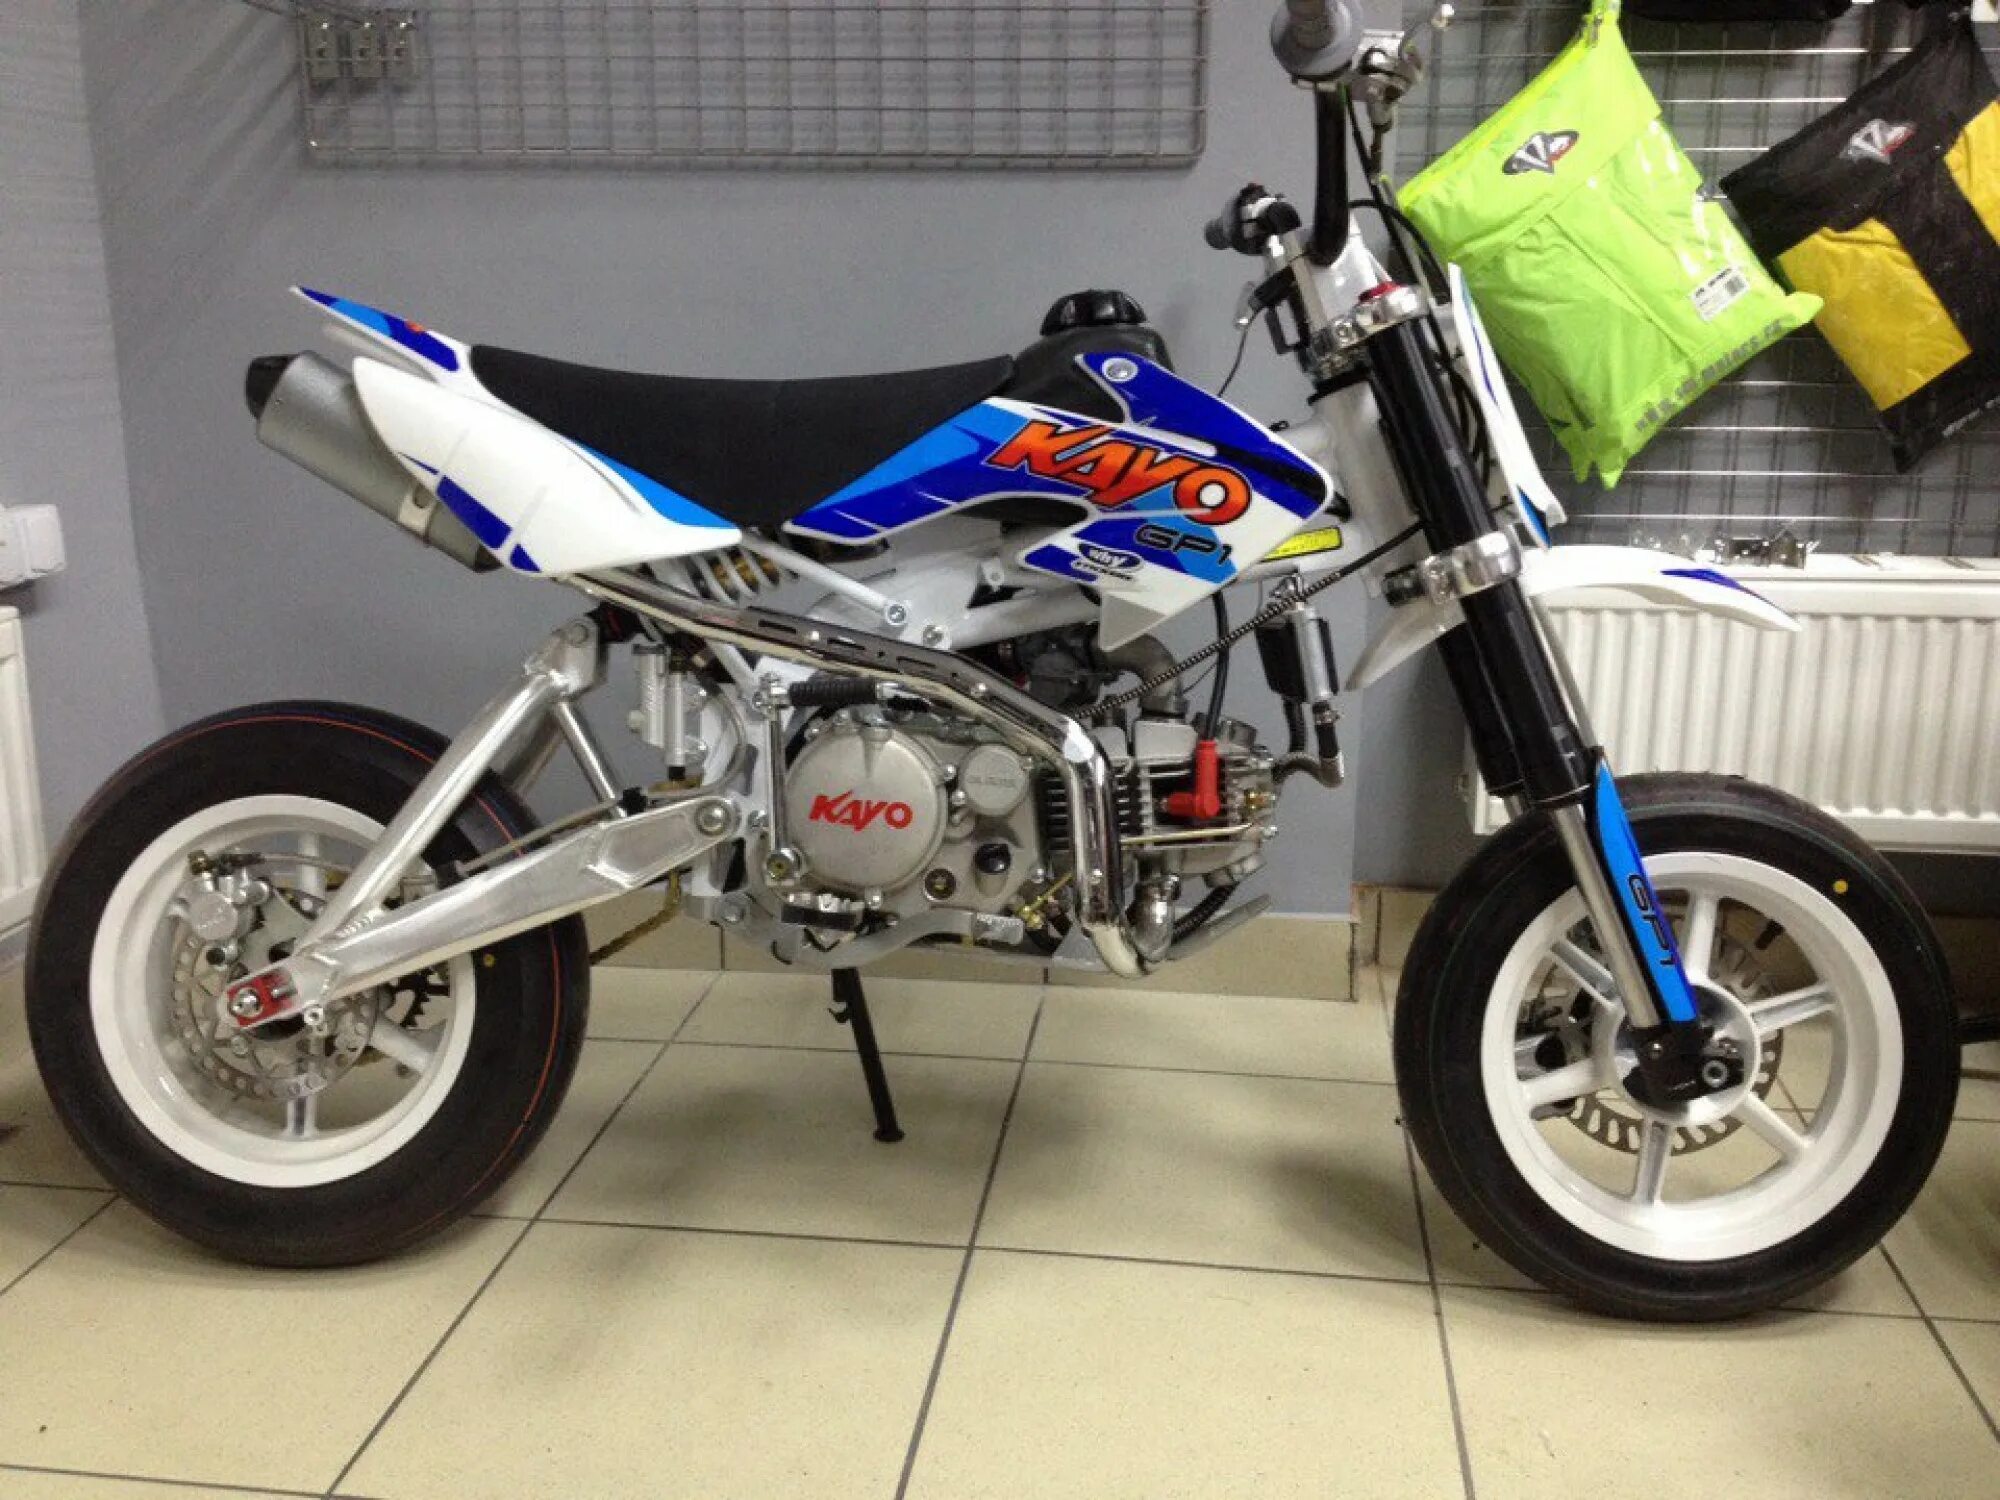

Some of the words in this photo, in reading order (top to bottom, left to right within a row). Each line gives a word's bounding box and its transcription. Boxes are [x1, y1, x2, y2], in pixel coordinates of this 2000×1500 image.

[985, 419, 1252, 525] KAYO
[1134, 524, 1233, 566] GP1
[808, 789, 914, 832] KAYO
